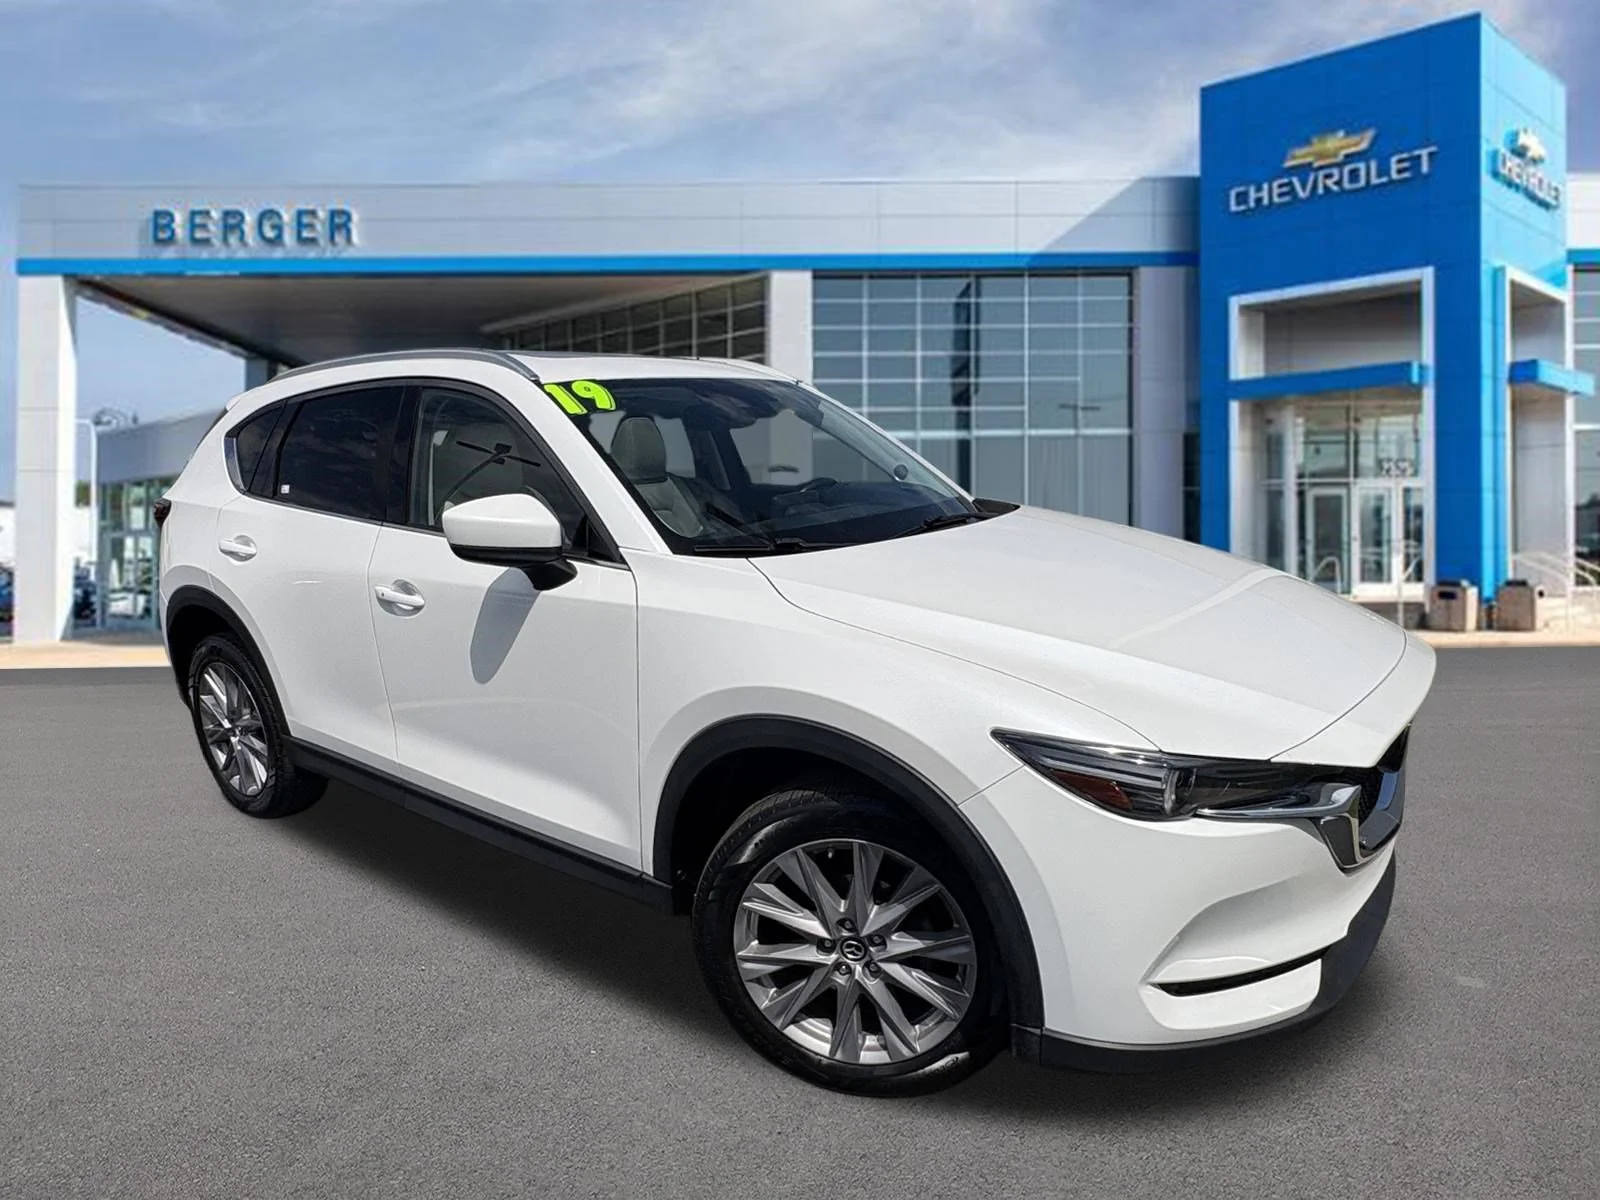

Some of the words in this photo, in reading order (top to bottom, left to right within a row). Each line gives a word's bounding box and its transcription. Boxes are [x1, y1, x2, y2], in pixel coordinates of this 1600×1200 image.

[1229, 146, 1438, 213] CHEVROLET
[152, 208, 356, 246] BERGER
[543, 380, 617, 415] 19
